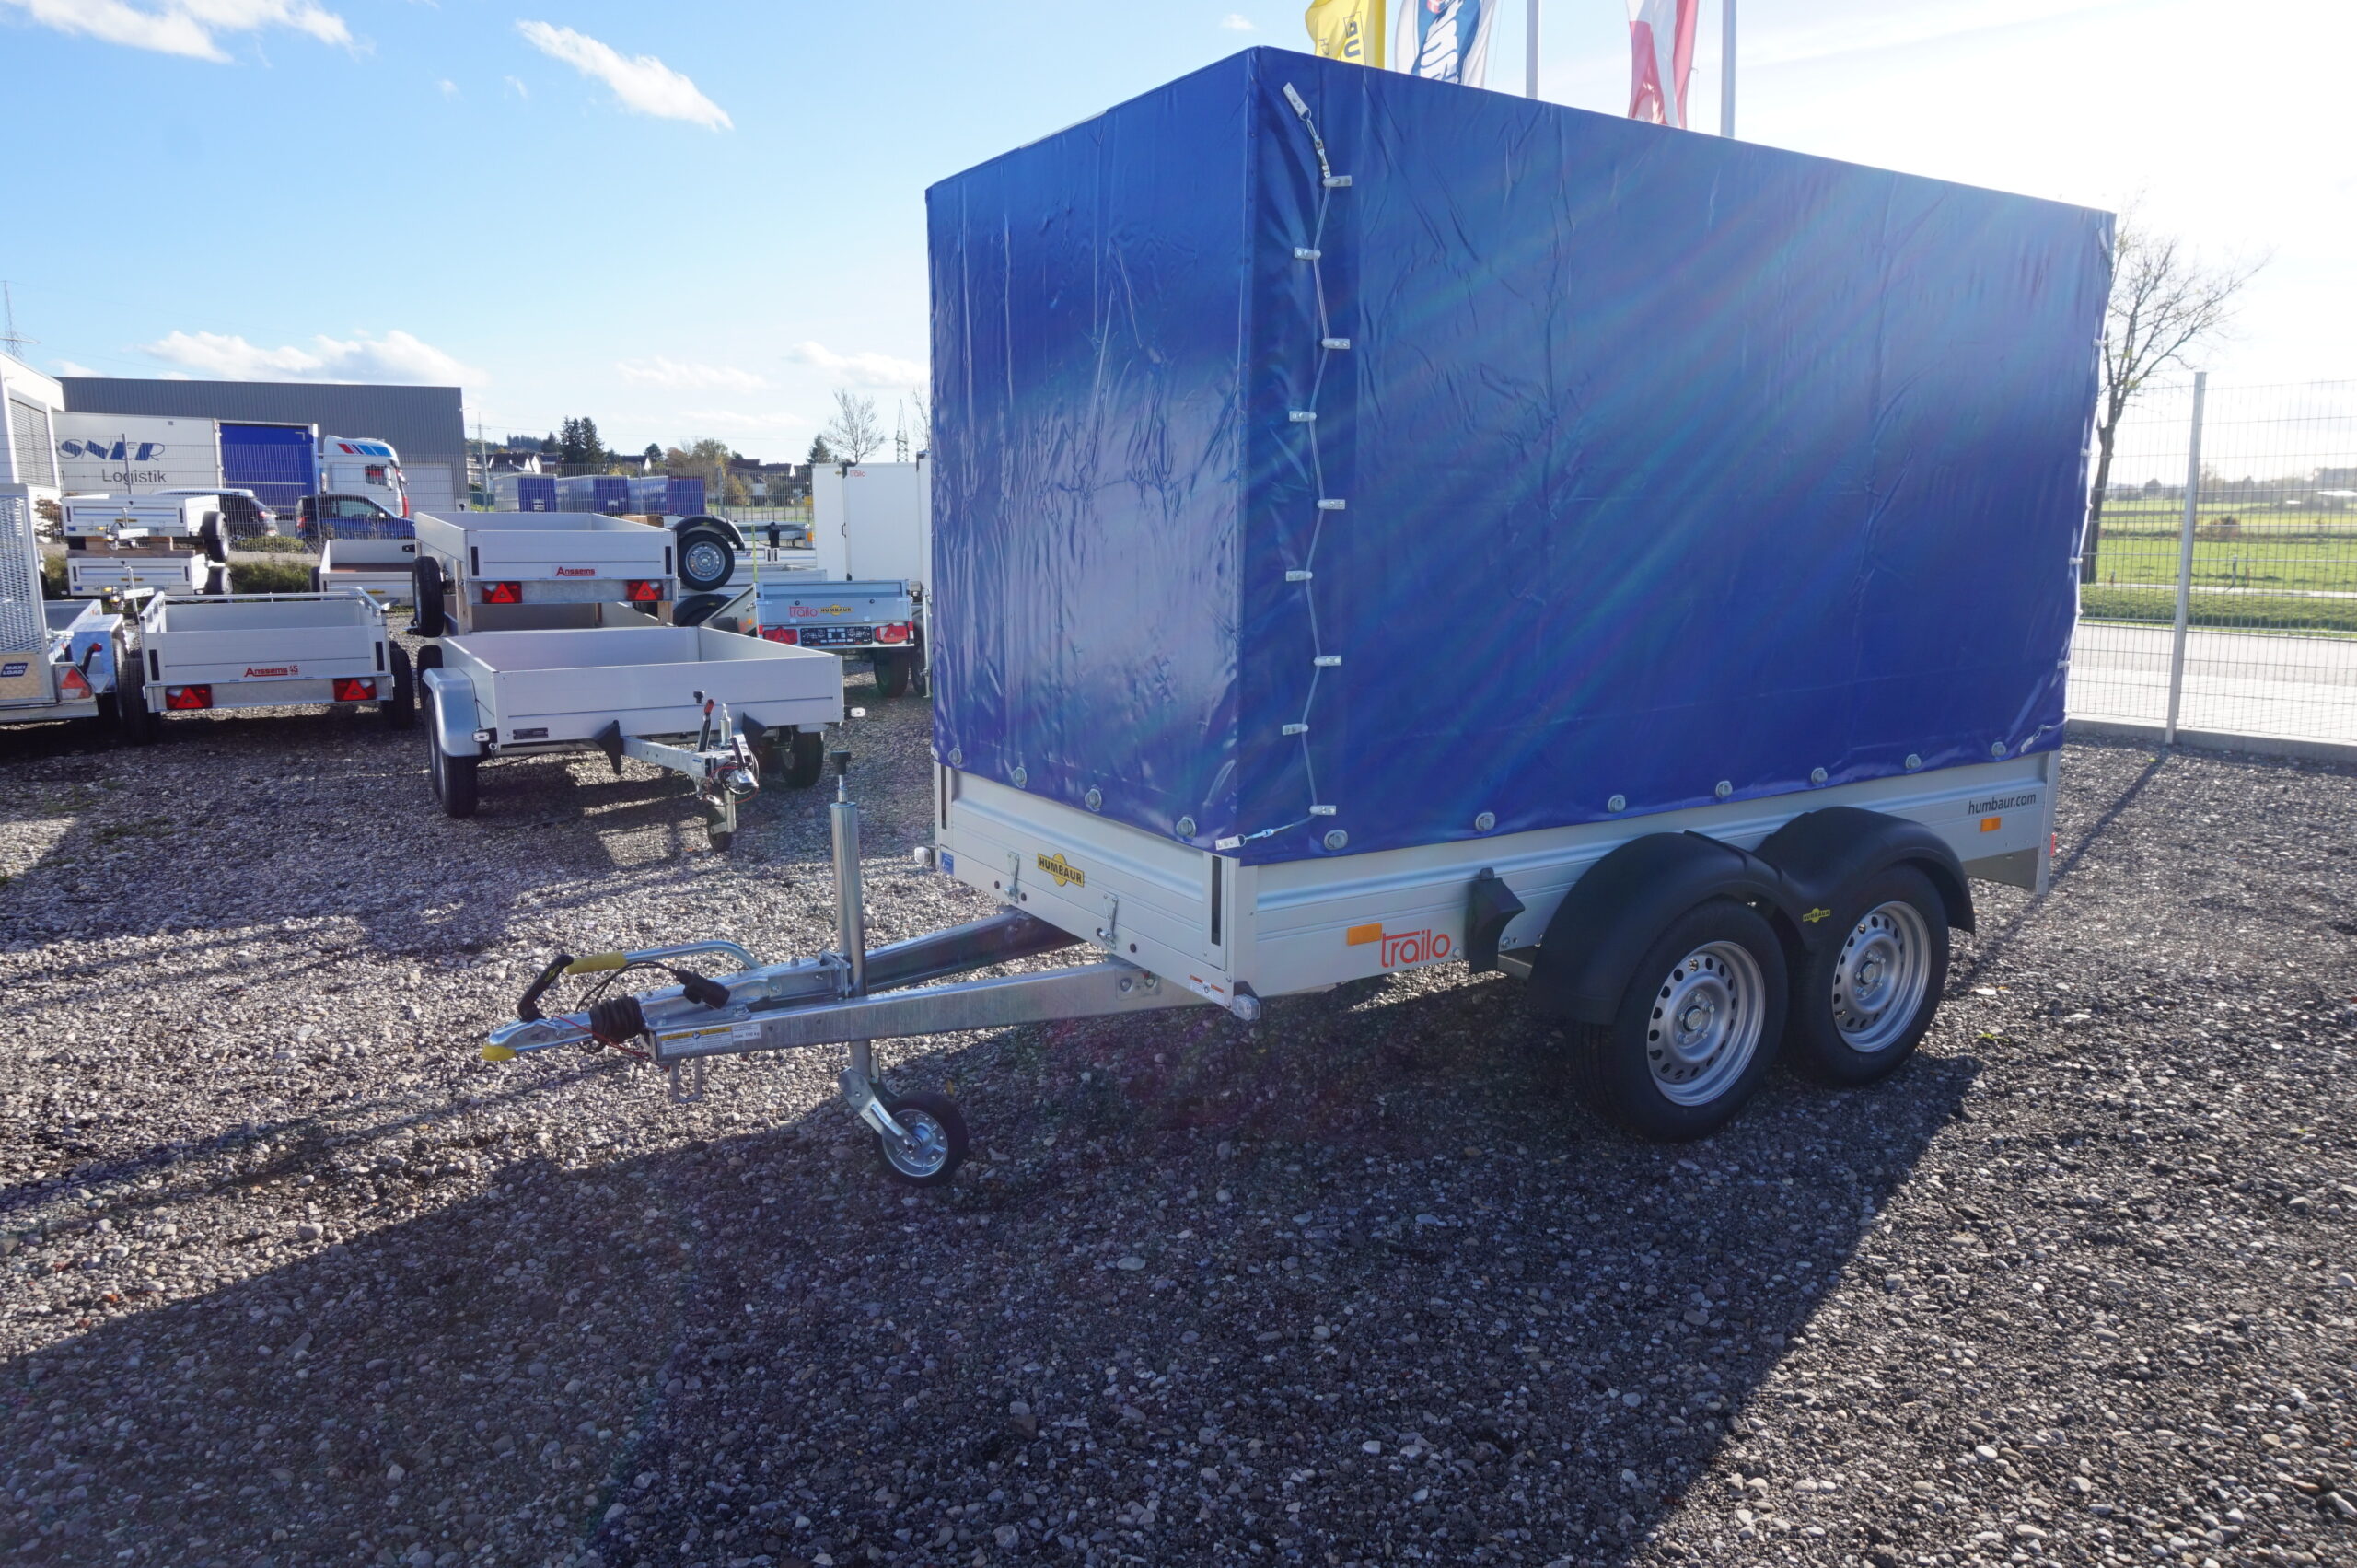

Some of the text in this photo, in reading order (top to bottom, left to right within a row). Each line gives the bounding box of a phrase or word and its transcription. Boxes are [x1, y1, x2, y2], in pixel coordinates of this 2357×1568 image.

[102, 468, 167, 485] Logistik
[555, 566, 596, 576] Anssems
[789, 606, 818, 618] trailo
[244, 667, 288, 678] Anssems
[1968, 794, 2037, 815] humbaur.com
[1039, 856, 1082, 885] HUMBAUR
[1803, 910, 1830, 921] HUMBAUR
[1381, 929, 1451, 968] trailo
